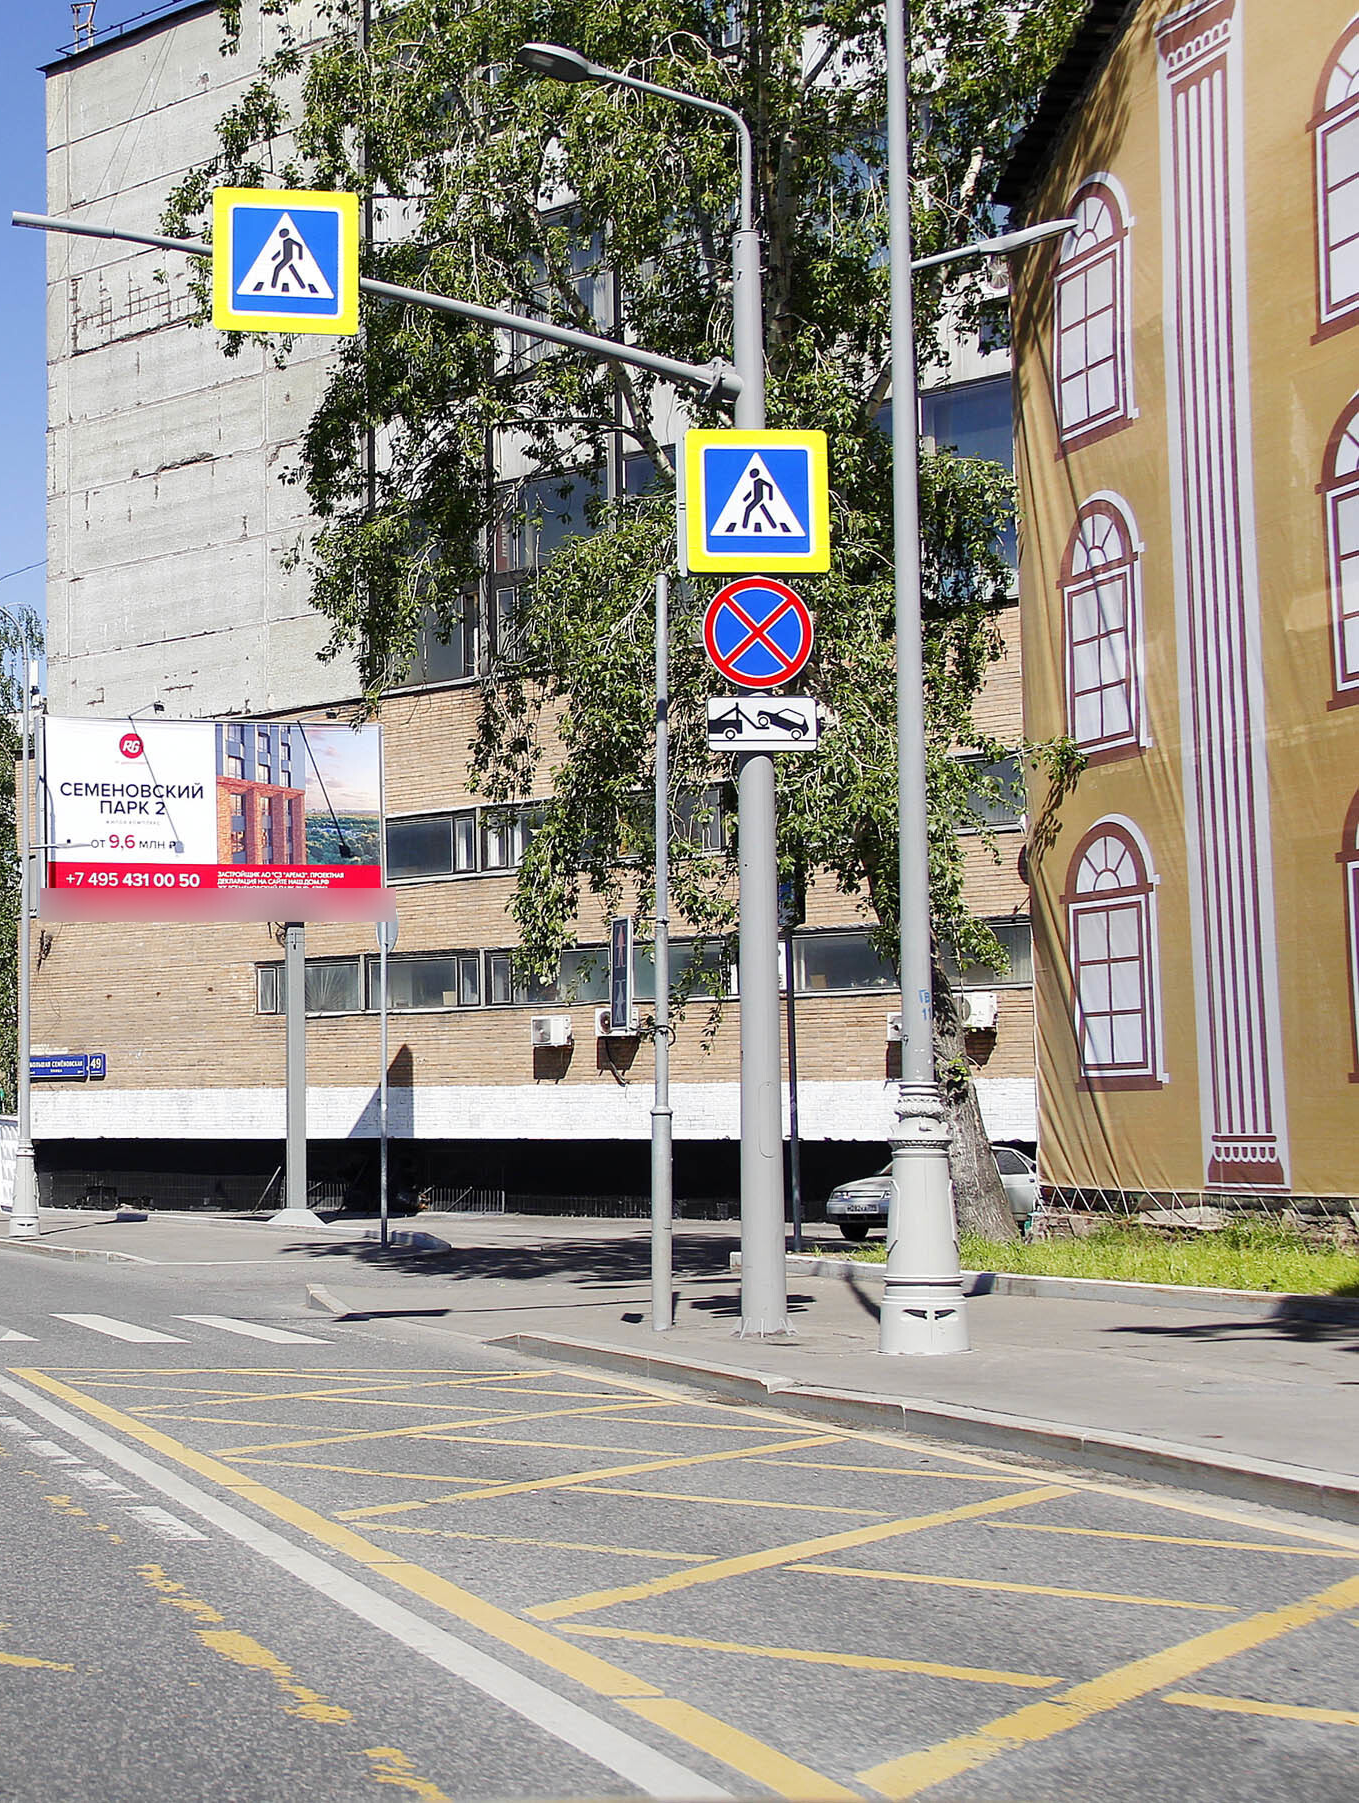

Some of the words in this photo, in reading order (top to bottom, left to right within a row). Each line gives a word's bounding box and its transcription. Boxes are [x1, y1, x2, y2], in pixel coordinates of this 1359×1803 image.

[122, 740, 140, 754] RG
[60, 782, 204, 799] СЕМЕНОВСКИЙ
[100, 800, 149, 815] ПАРК
[155, 801, 166, 815] 2
[109, 834, 135, 850] 9,6
[66, 872, 84, 886] +7
[88, 872, 119, 886] 495
[122, 873, 149, 886] 431
[153, 873, 175, 887] 00
[179, 873, 201, 887] 50
[90, 1057, 102, 1069] 49
